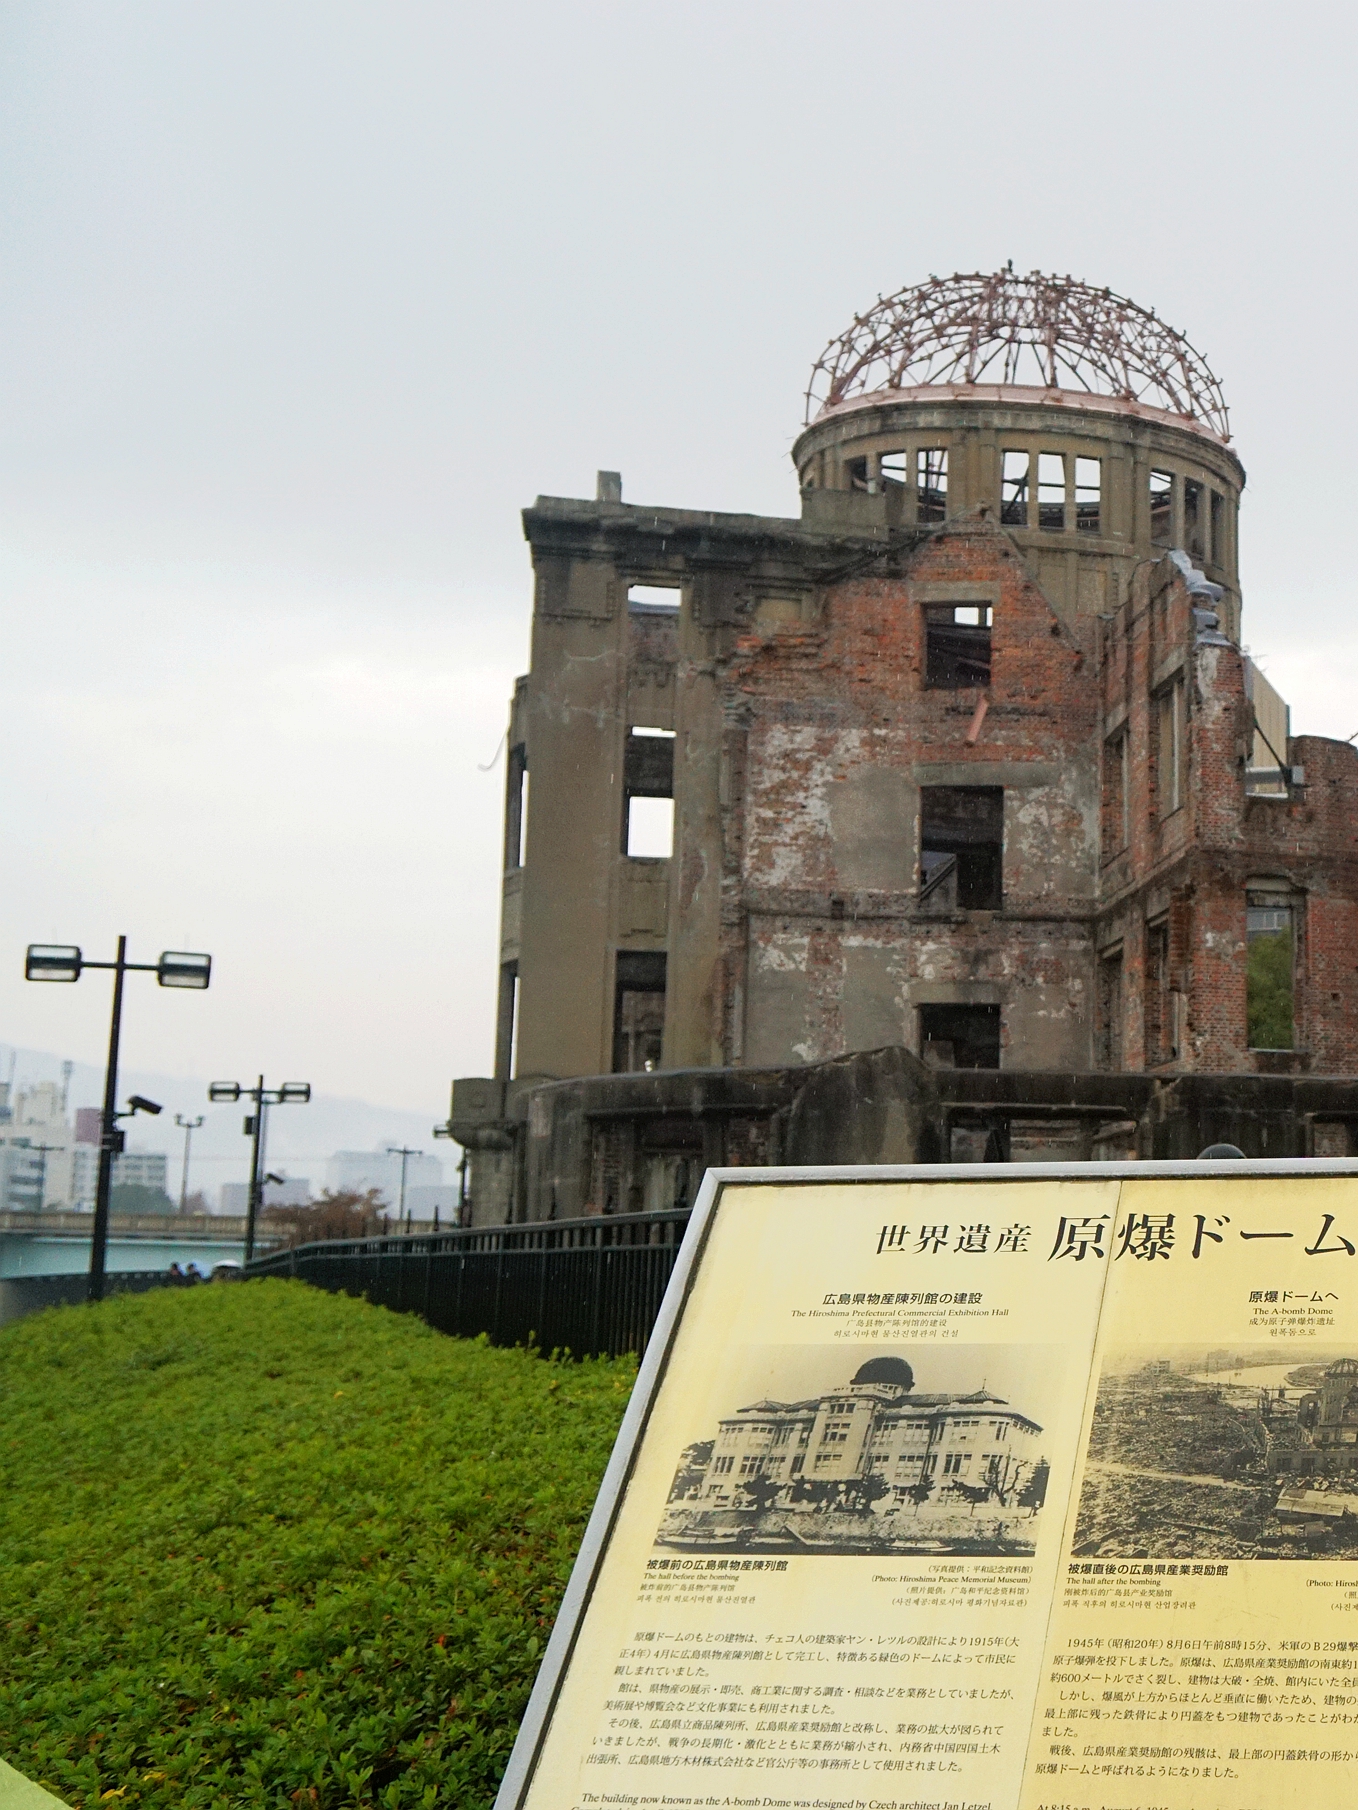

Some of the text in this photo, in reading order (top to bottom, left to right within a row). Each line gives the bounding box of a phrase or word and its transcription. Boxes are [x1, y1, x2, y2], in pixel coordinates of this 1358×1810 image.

[875, 1213, 1356, 1262] 世界遺産 原爆ドーム
[822, 1291, 983, 1306] 広島県物産陳列館の建設
[1248, 1290, 1339, 1303] 原爆ドームへ
[791, 1308, 1010, 1317] The Hiroshima Prefectural Commercial Exhibition Hall
[1253, 1307, 1334, 1315] The A-bomb Dome
[646, 1559, 789, 1572] 被爆前の広島県物産陳列館
[1067, 1563, 1229, 1577] 被爆直後の広島県産業奨励館
[672, 1573, 696, 1581] before
[697, 1573, 708, 1581] the
[709, 1574, 740, 1582] bombing
[899, 1575, 936, 1584] Hiroshima
[938, 1575, 959, 1584] Peace
[960, 1575, 996, 1584] Memorial
[997, 1575, 1032, 1585] Museum)
[1066, 1577, 1161, 1587] The hall after the bombing
[1041, 1726, 1080, 1738] ました。
[582, 1793, 599, 1802] The
[601, 1793, 638, 1806] building
[640, 1795, 660, 1804] now
[661, 1794, 691, 1805] known
[694, 1797, 704, 1805] as
[705, 1796, 721, 1806] the
[722, 1796, 760, 1807] A-bomb
[762, 1797, 791, 1807] Dome
[793, 1800, 811, 1808] was
[812, 1798, 854, 1810] designed
[856, 1799, 868, 1810] by
[868, 1799, 897, 1810] Czech
[899, 1800, 941, 1810] architect
[941, 1801, 960, 1810] Jan
